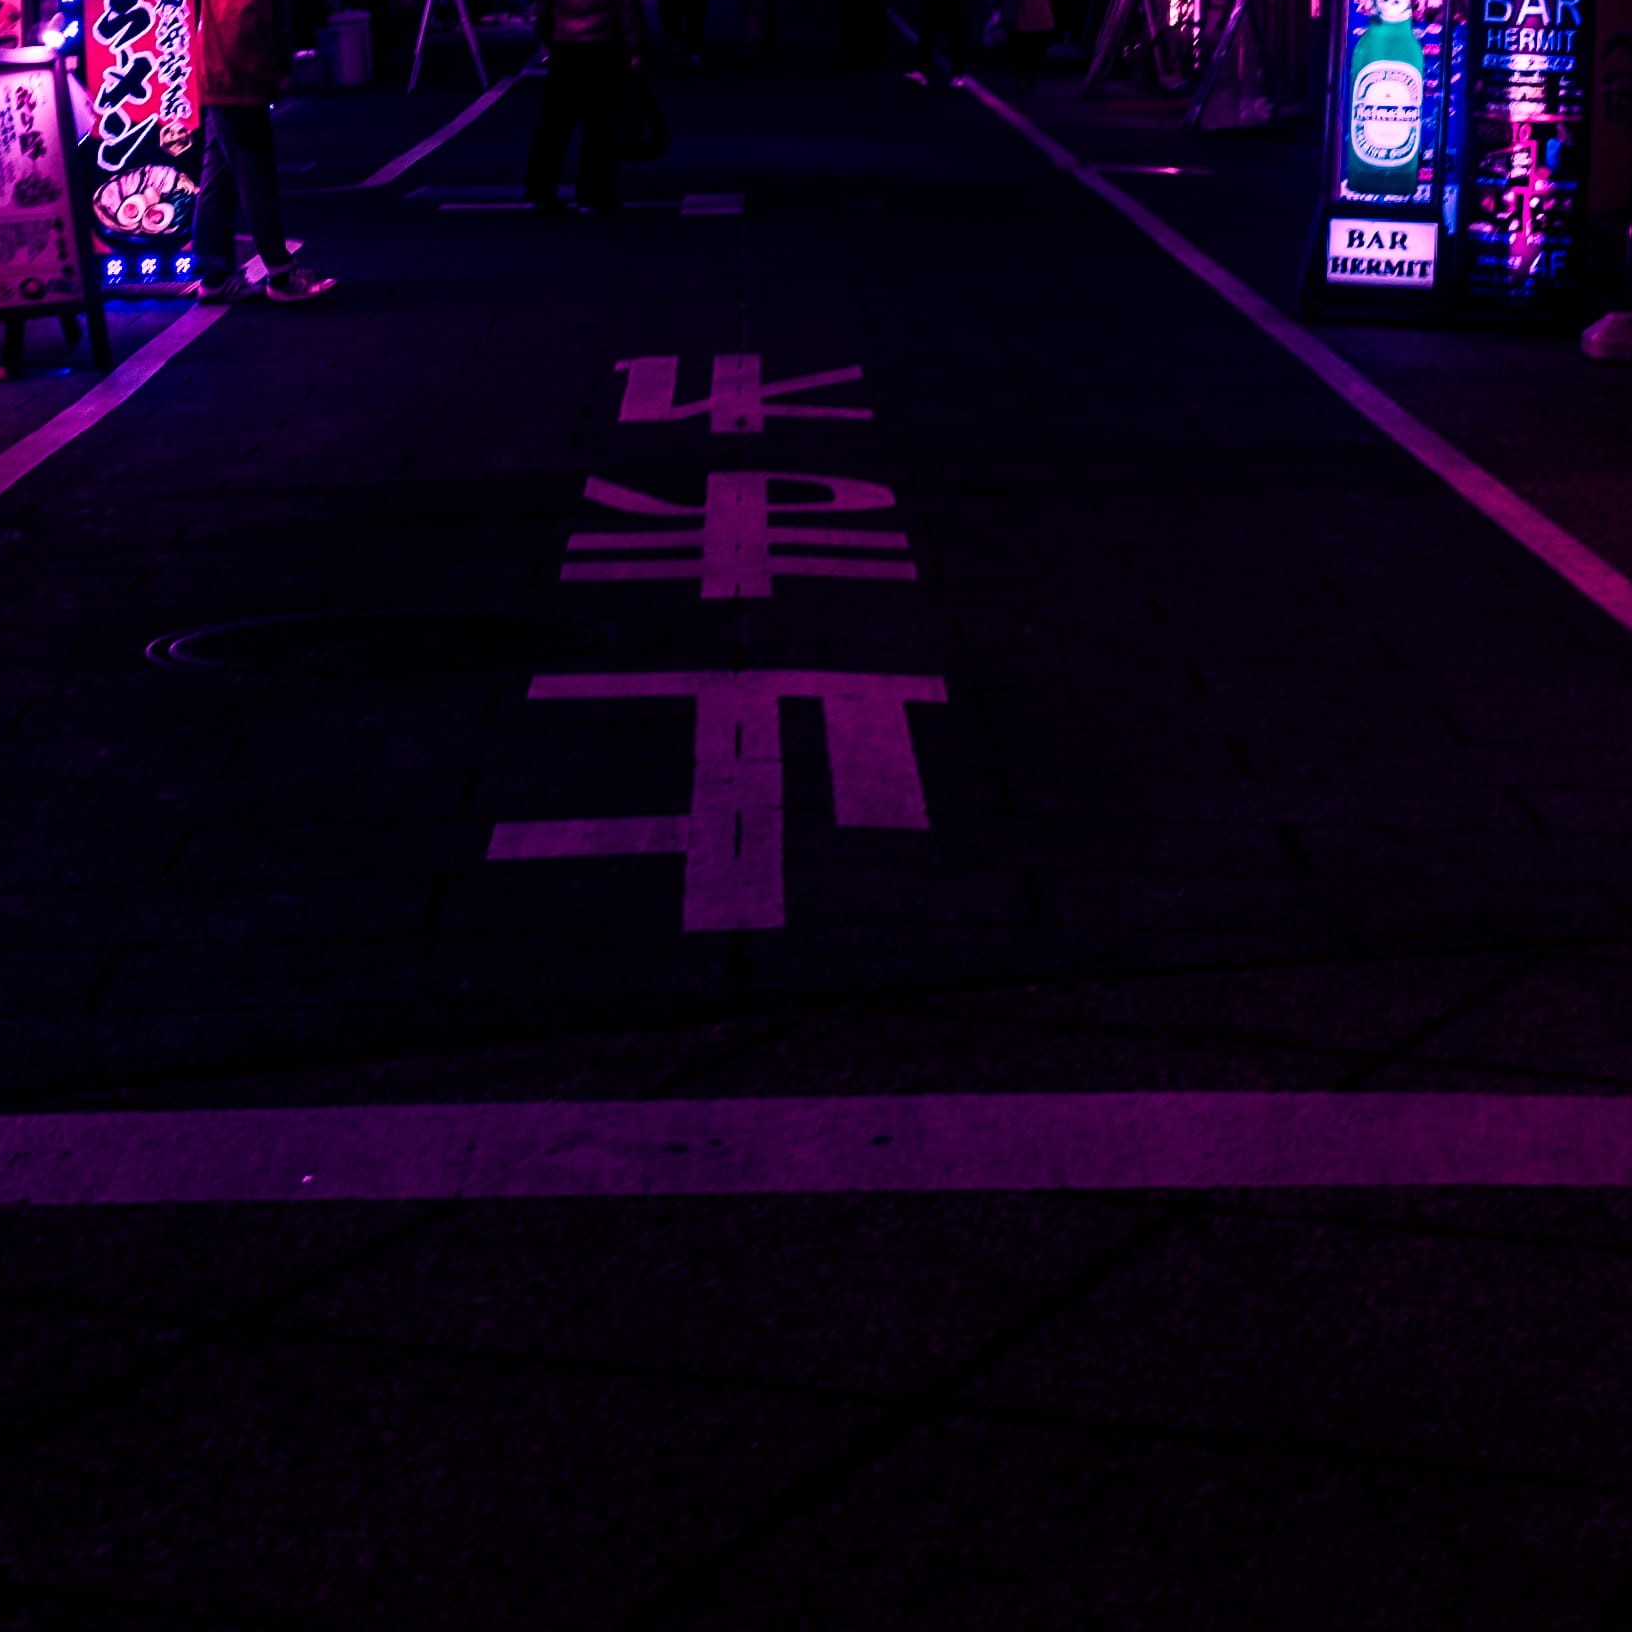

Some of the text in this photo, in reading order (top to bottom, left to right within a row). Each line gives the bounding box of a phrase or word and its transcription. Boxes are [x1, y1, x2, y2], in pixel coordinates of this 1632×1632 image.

[1486, 27, 1578, 54] HERMIT
[1347, 228, 1407, 251] BAR
[1330, 256, 1431, 279] HERMIT
